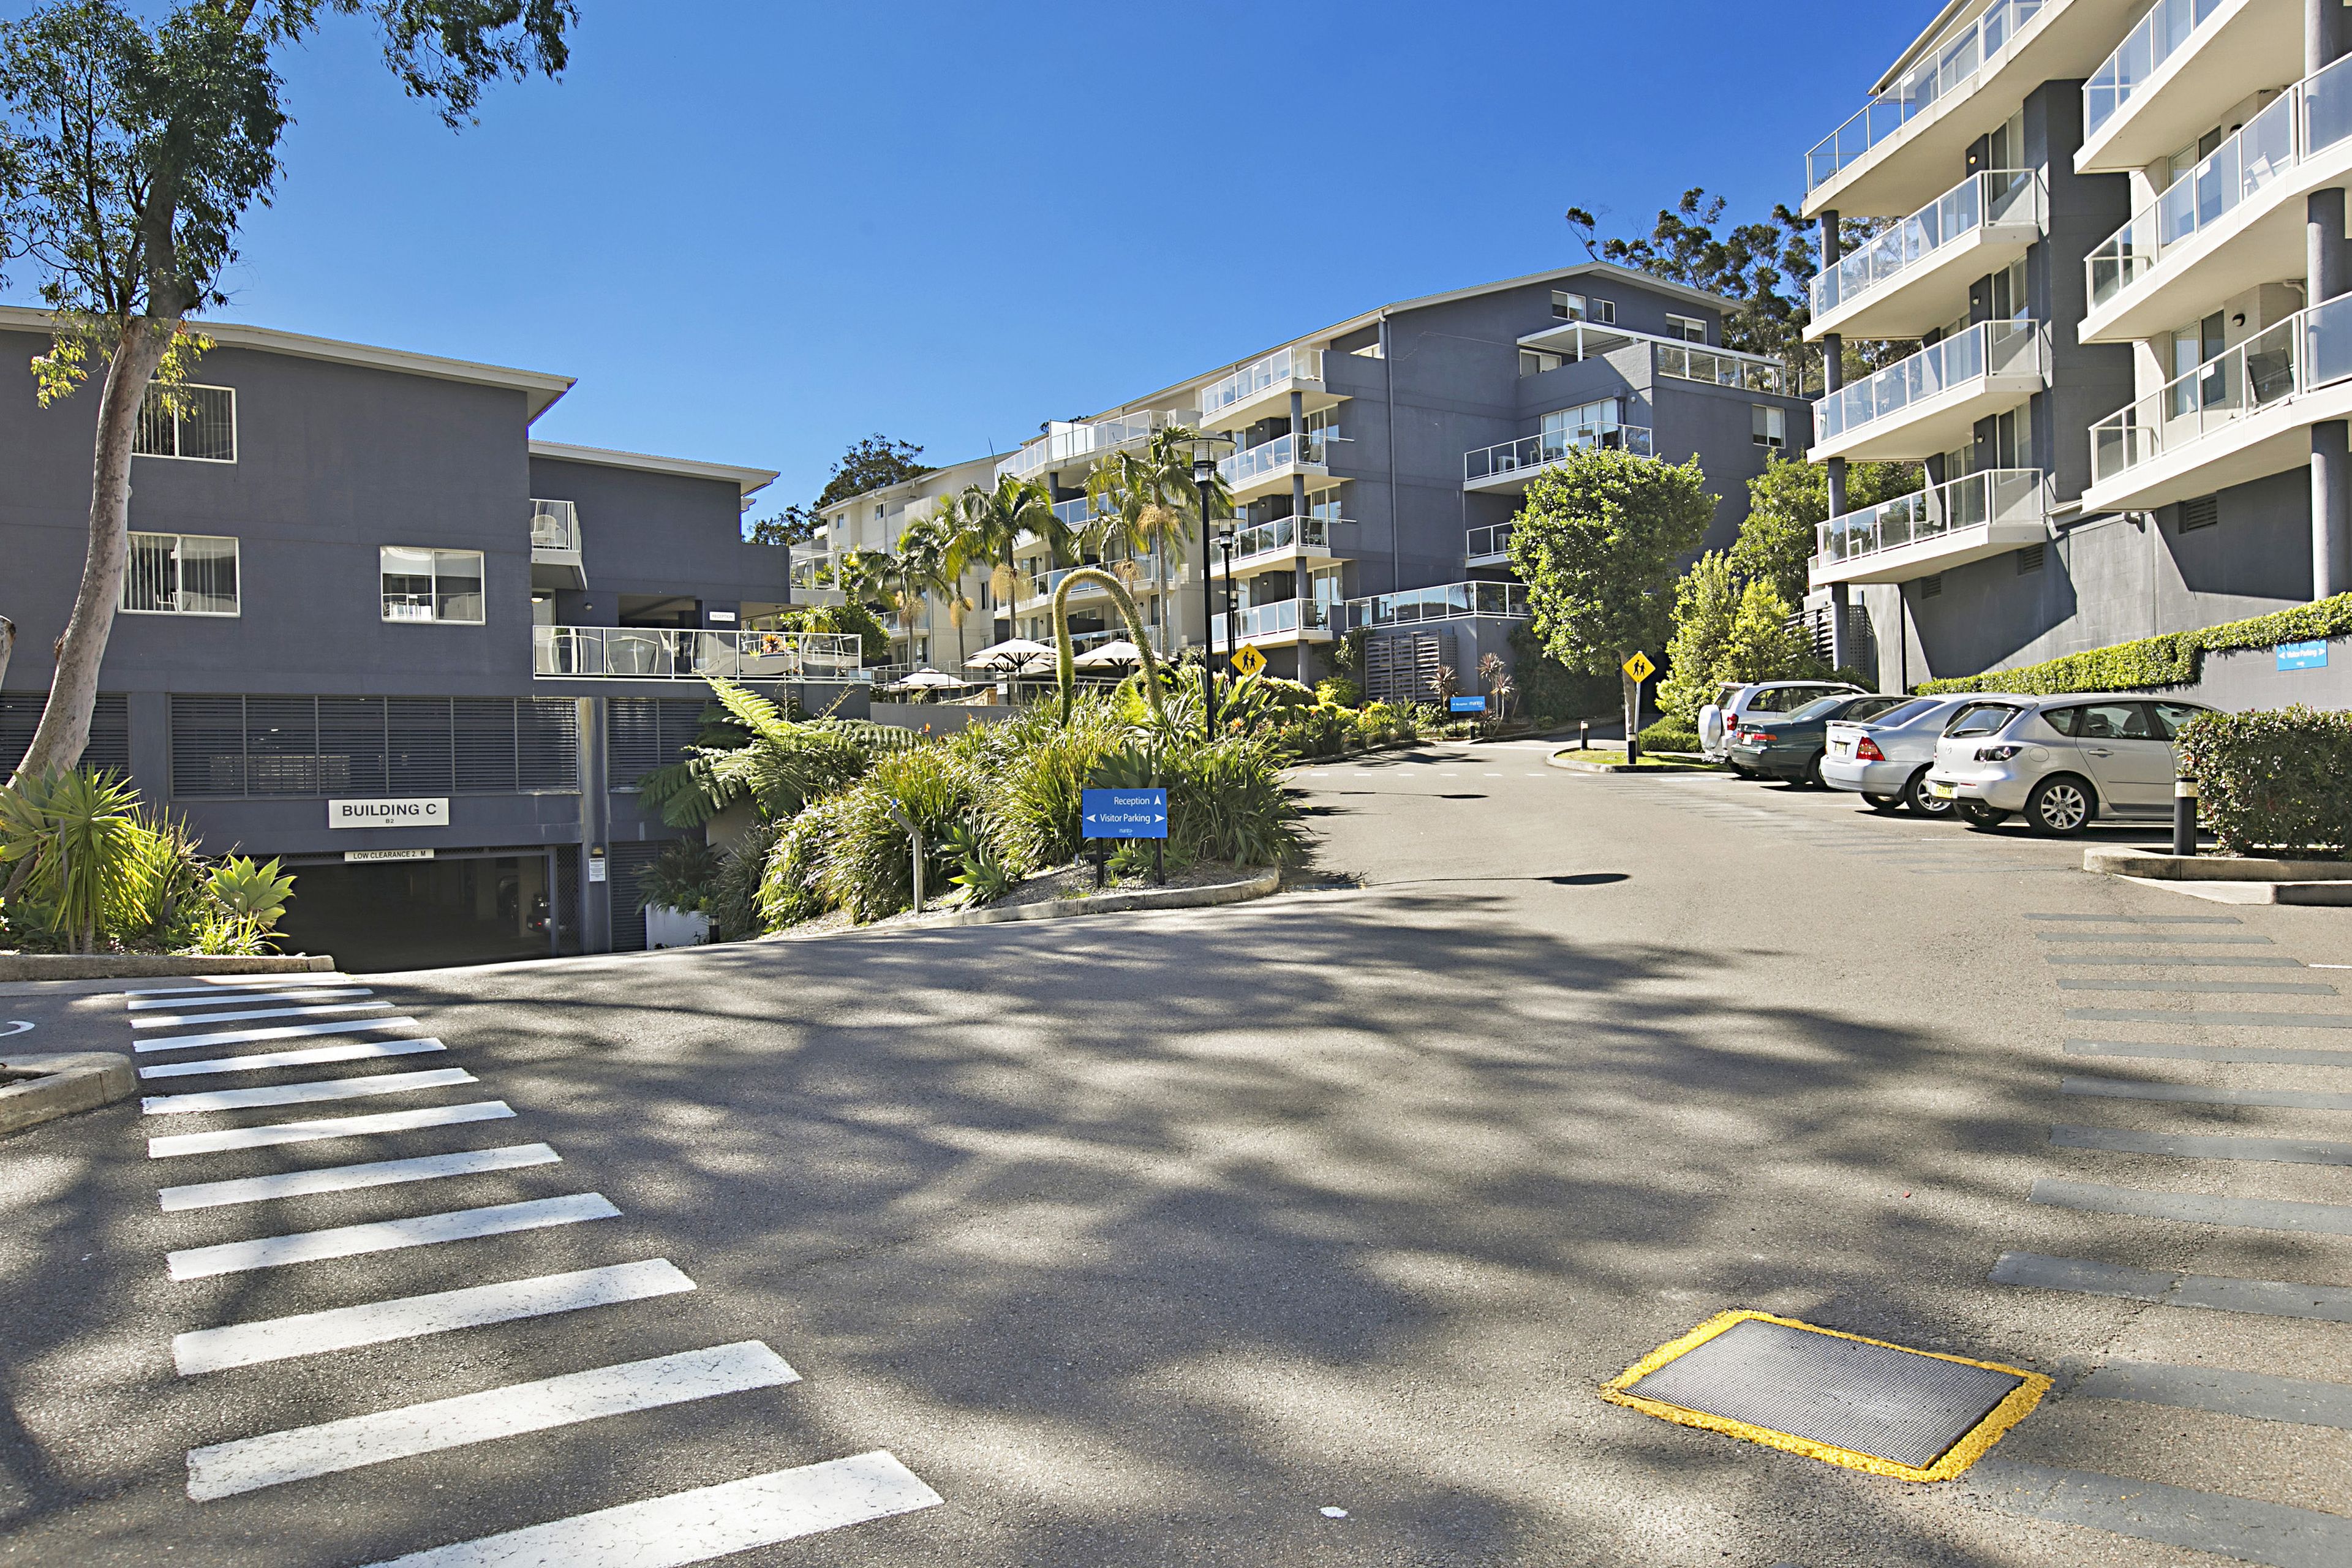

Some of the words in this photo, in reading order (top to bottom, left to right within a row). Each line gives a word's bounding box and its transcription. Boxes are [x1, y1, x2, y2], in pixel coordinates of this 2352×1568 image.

[1114, 797, 1150, 807] Reception
[342, 804, 420, 816] BUILDING
[426, 803, 437, 815] C
[1123, 814, 1150, 824] Parking
[370, 850, 410, 858] CLEARANCE
